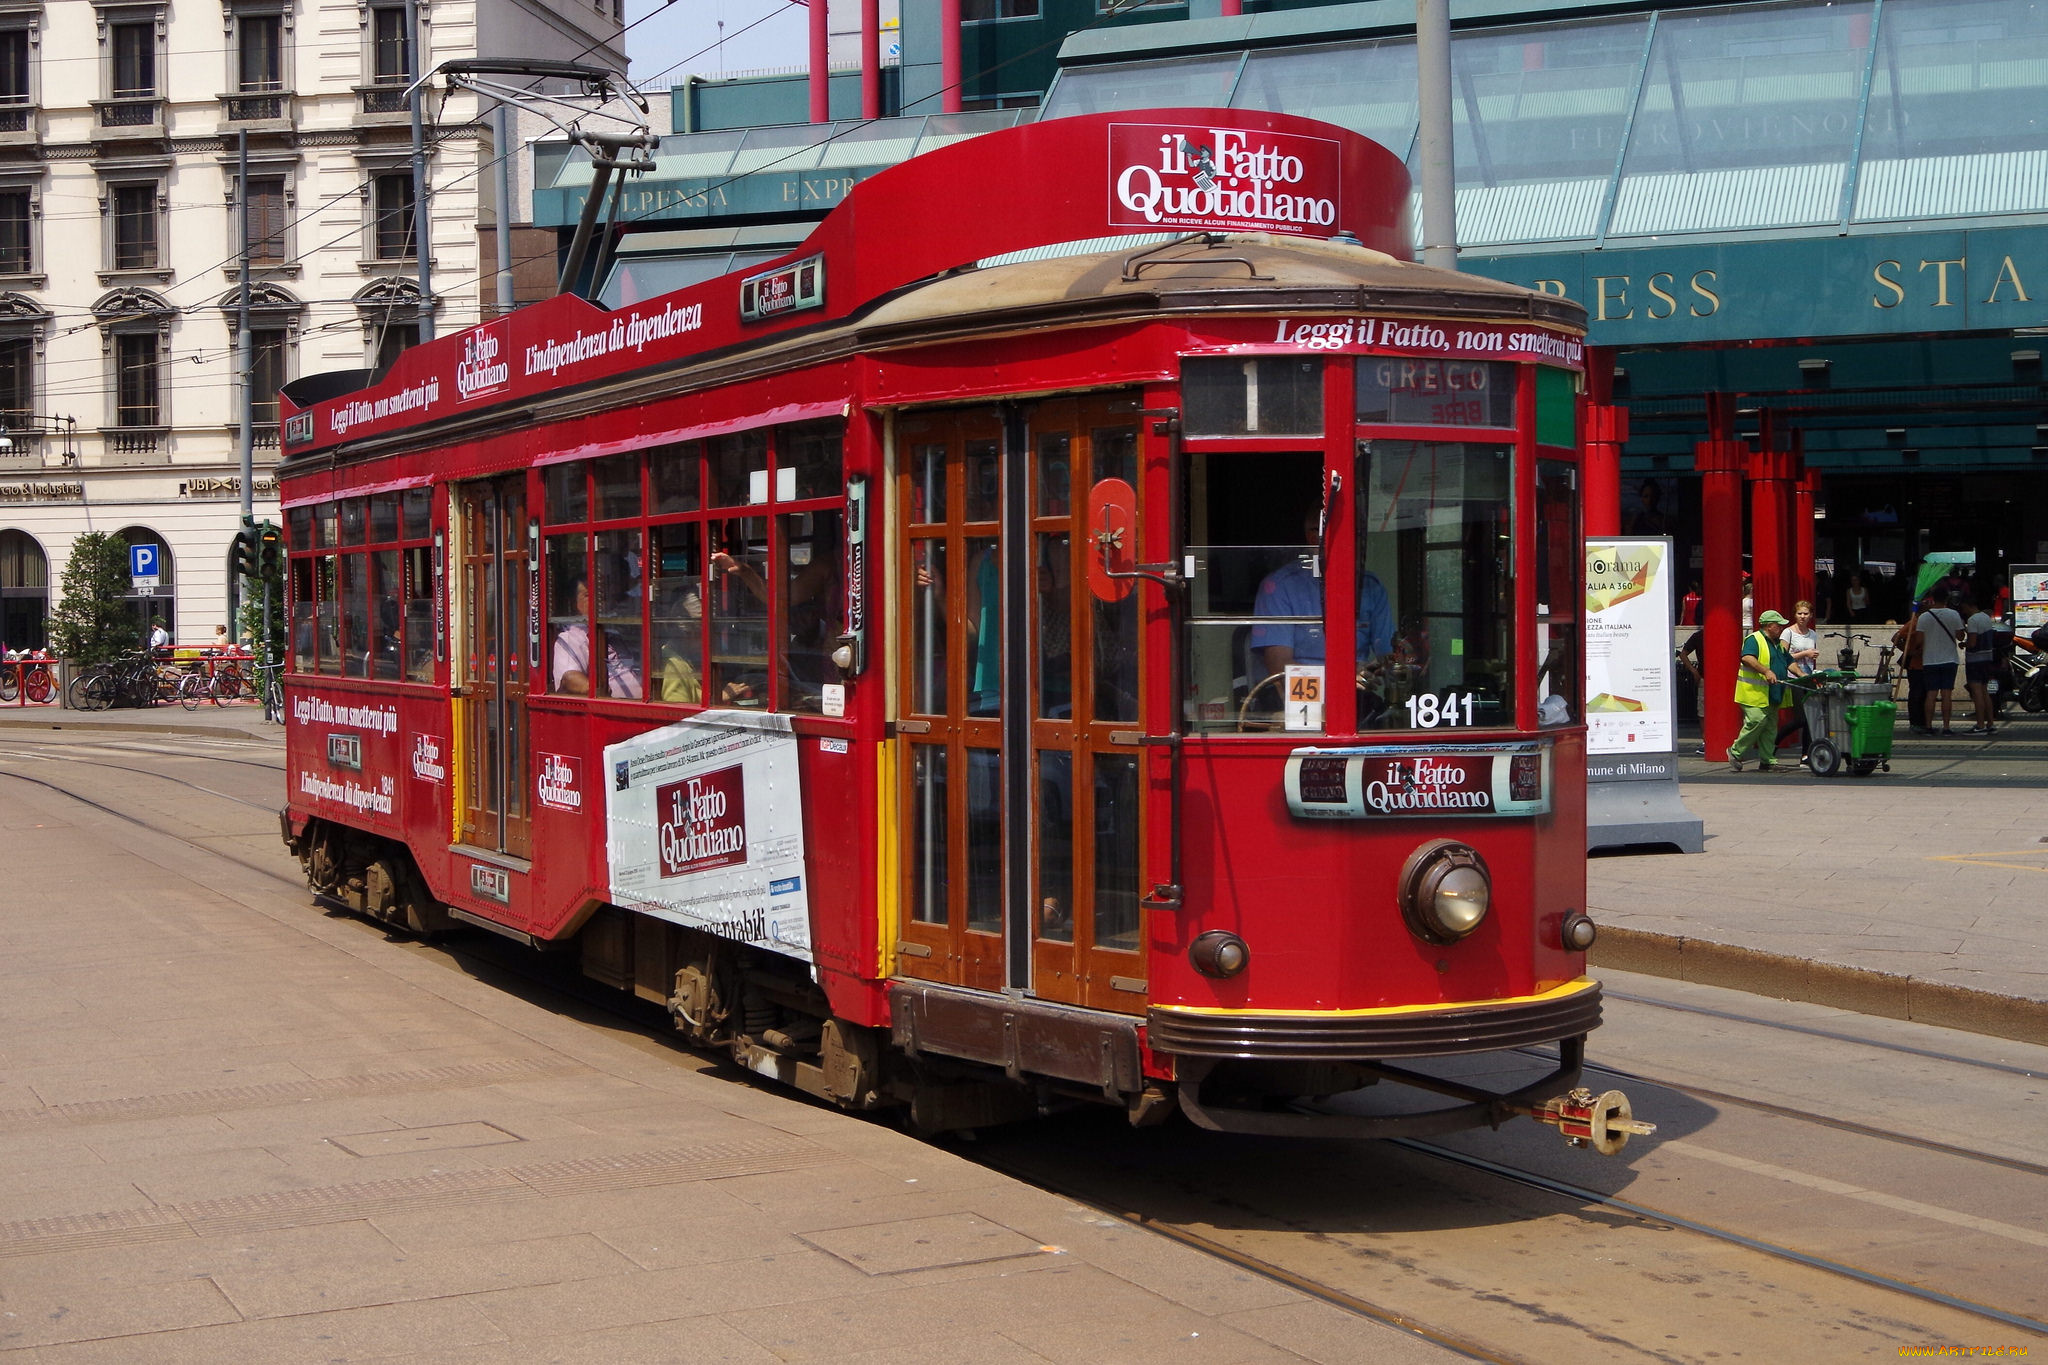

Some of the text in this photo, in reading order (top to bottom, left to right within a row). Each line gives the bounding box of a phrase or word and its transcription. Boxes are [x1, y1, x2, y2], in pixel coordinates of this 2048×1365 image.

[1160, 129, 1304, 184] il Fatto
[1117, 165, 1336, 226] Quotidiano
[1179, 217, 1203, 225] RICEVE
[1227, 220, 1275, 230] FINANZIAMENTO
[1275, 224, 1303, 232] PUBBLICO
[465, 327, 499, 366] il Fatto
[525, 301, 703, 377] L'indipendenza dà dipendenza
[1274, 318, 1582, 365] Leggi il Fatto, non smetterai più
[457, 358, 508, 400] Quotidiano
[1376, 362, 1488, 391] GRECO
[330, 402, 348, 435] Leggi
[348, 401, 355, 427] il
[354, 400, 374, 424] Fatto,
[374, 398, 389, 419] non
[388, 379, 425, 415] smetterai
[424, 375, 439, 412] più
[32, 482, 82, 495] Industria
[188, 478, 210, 491] UBI
[136, 549, 153, 573] P
[1587, 582, 1607, 590] ALIA
[1609, 582, 1616, 590] A
[1291, 678, 1318, 700] 45
[294, 695, 311, 725] Leggi
[315, 698, 335, 727] Fatto,
[335, 705, 349, 726] non
[349, 704, 383, 731] smetterai
[382, 704, 398, 738] più
[1299, 704, 1308, 727] 1
[1405, 692, 1473, 729] 1841
[423, 734, 439, 760] Fatto
[413, 750, 445, 780] Quotidiano
[552, 755, 573, 784] Fatto
[1386, 758, 1466, 785] il Fatto
[1616, 763, 1627, 774] di
[1629, 762, 1665, 774] Milano
[301, 771, 393, 815] L'indipendenza dà dipendenza
[538, 774, 581, 807] Quotidiano
[672, 777, 727, 828] il Fatto
[1366, 780, 1490, 814] Quotidiano
[660, 819, 744, 873] Quotidiano
